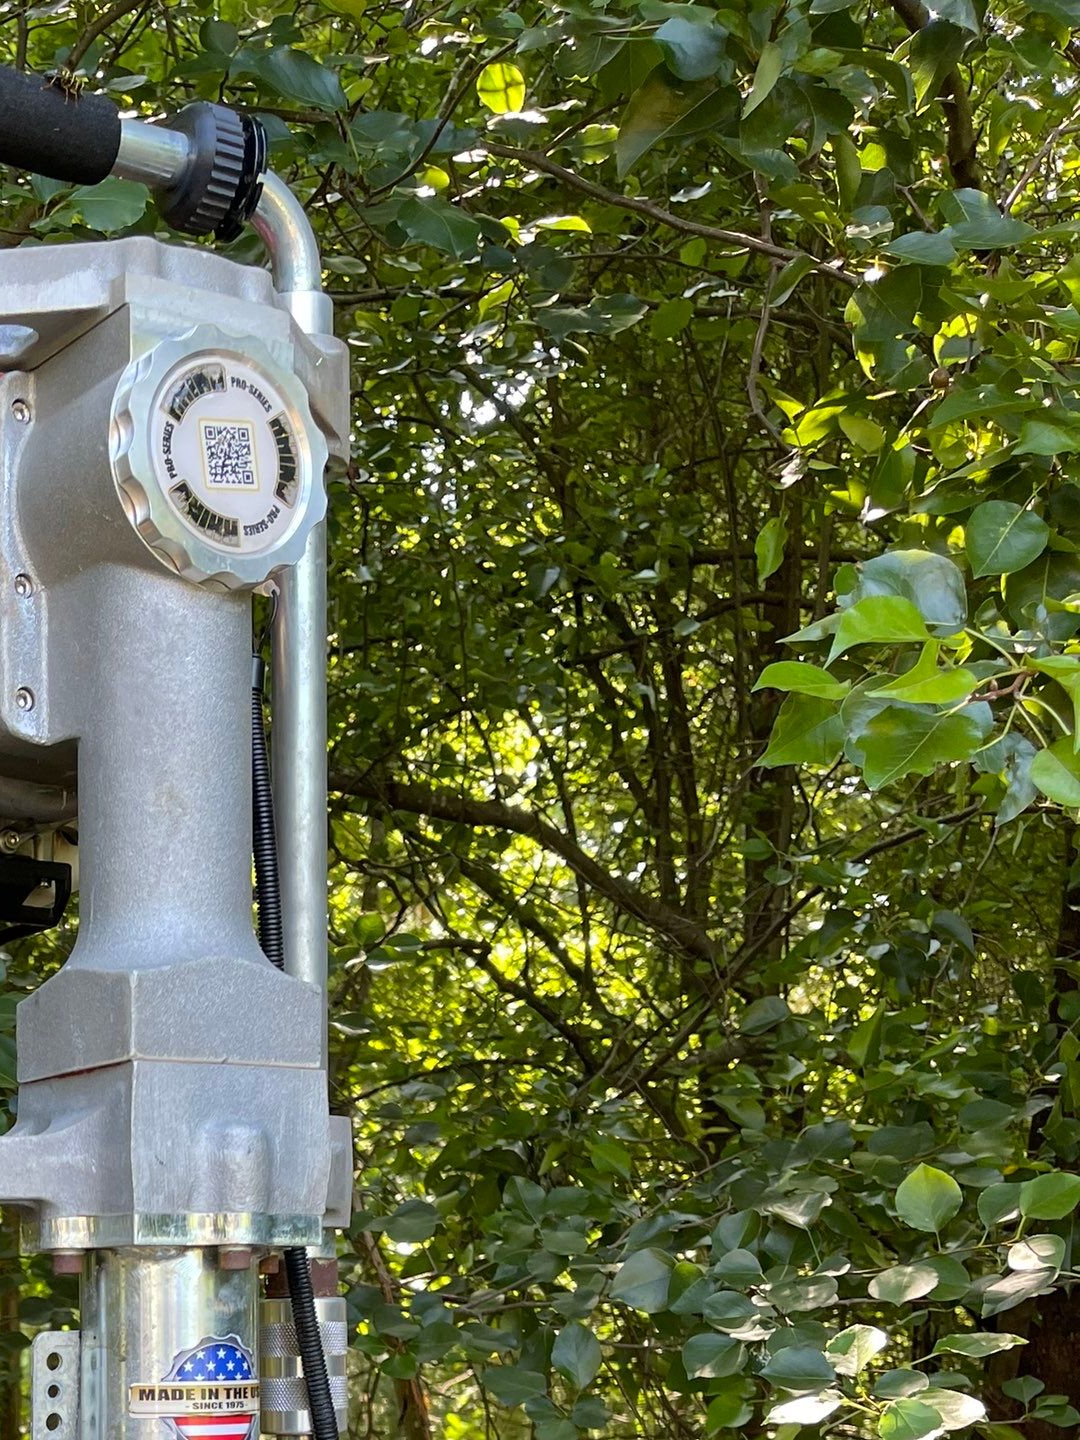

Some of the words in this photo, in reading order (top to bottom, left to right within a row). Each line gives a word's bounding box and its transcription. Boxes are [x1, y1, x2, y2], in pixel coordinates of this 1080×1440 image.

[230, 376, 273, 413] PRO-SERIES
[162, 421, 178, 480] PRO-SERIES
[244, 505, 281, 537] PRO-SERIES
[139, 1388, 196, 1401] MADE
[201, 1387, 219, 1400] IN
[224, 1387, 249, 1400] THE
[192, 1401, 224, 1410] SINCE
[226, 1400, 245, 1409] 1975
